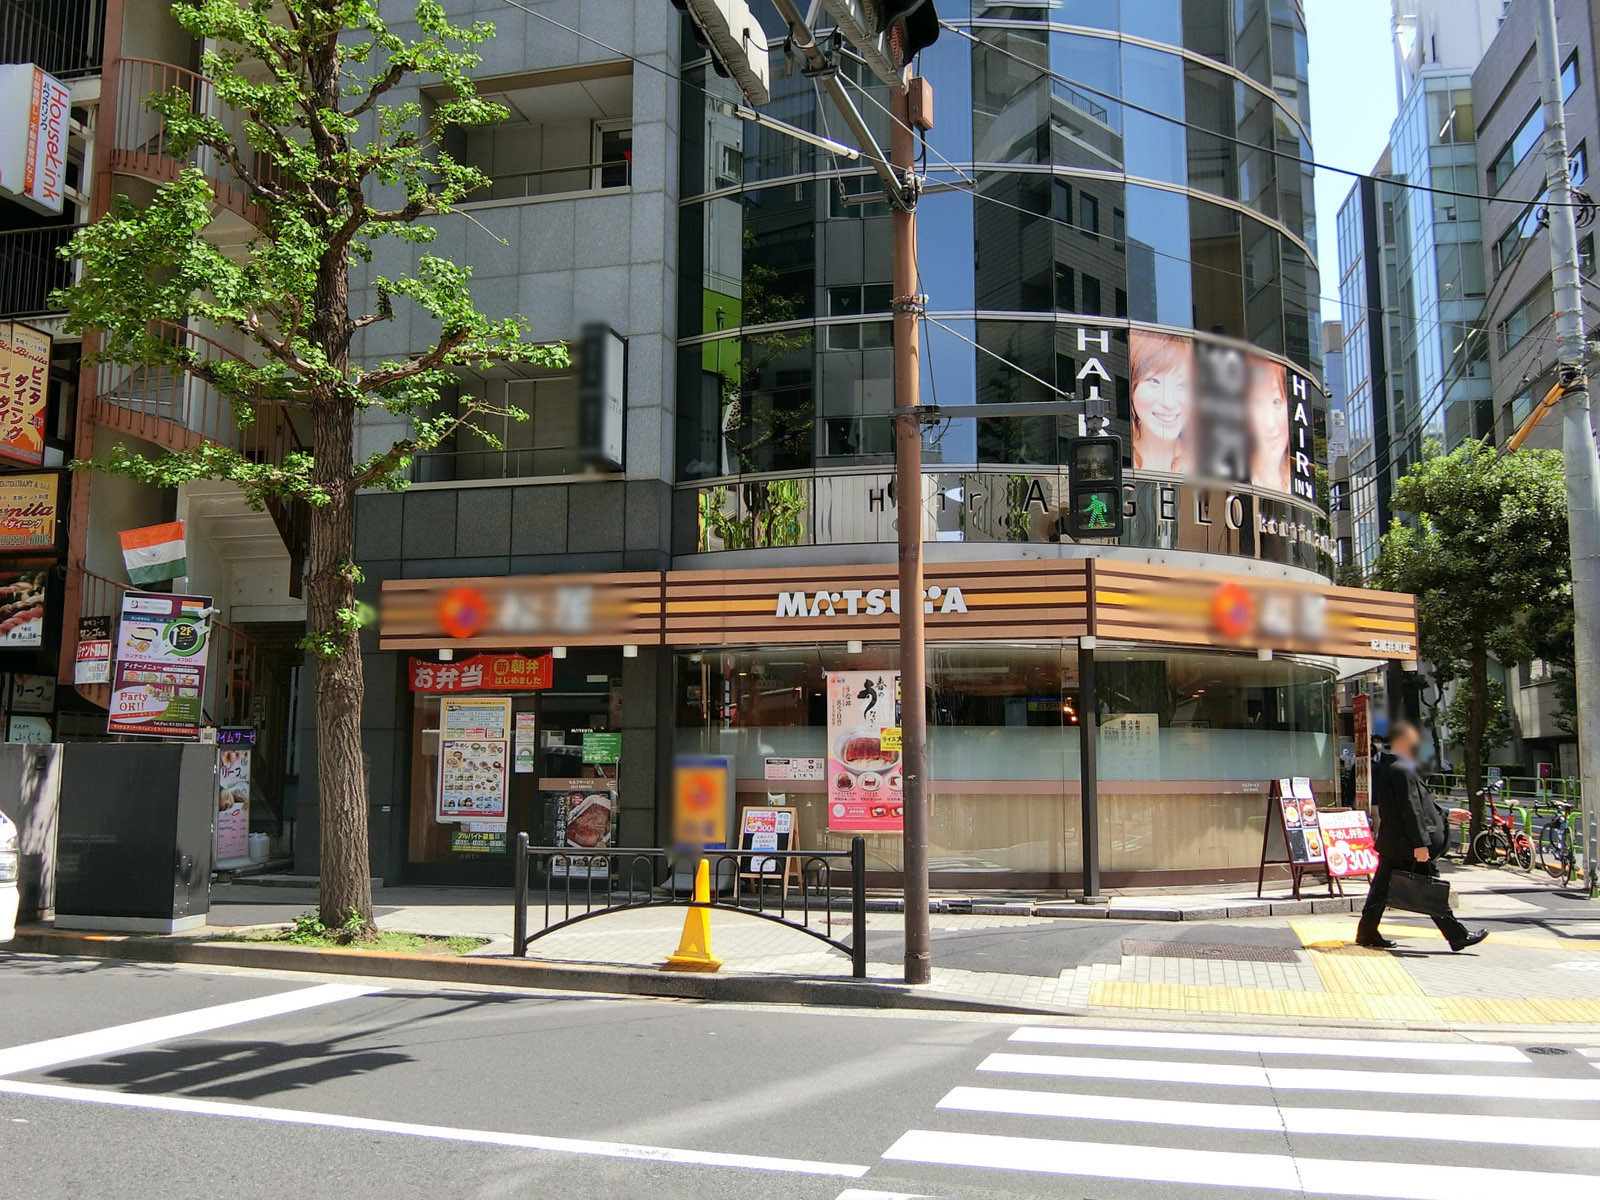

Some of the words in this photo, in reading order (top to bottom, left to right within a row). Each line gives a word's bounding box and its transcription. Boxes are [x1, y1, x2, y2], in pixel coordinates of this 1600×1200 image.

[1292, 374, 1310, 477] HAIR
[868, 486, 982, 513] Hir
[1022, 479, 1245, 530] AGELO
[414, 664, 484, 689] お弁当
[494, 676, 541, 685] はじめました
[120, 692, 148, 702] Party
[119, 702, 145, 711] OK!!
